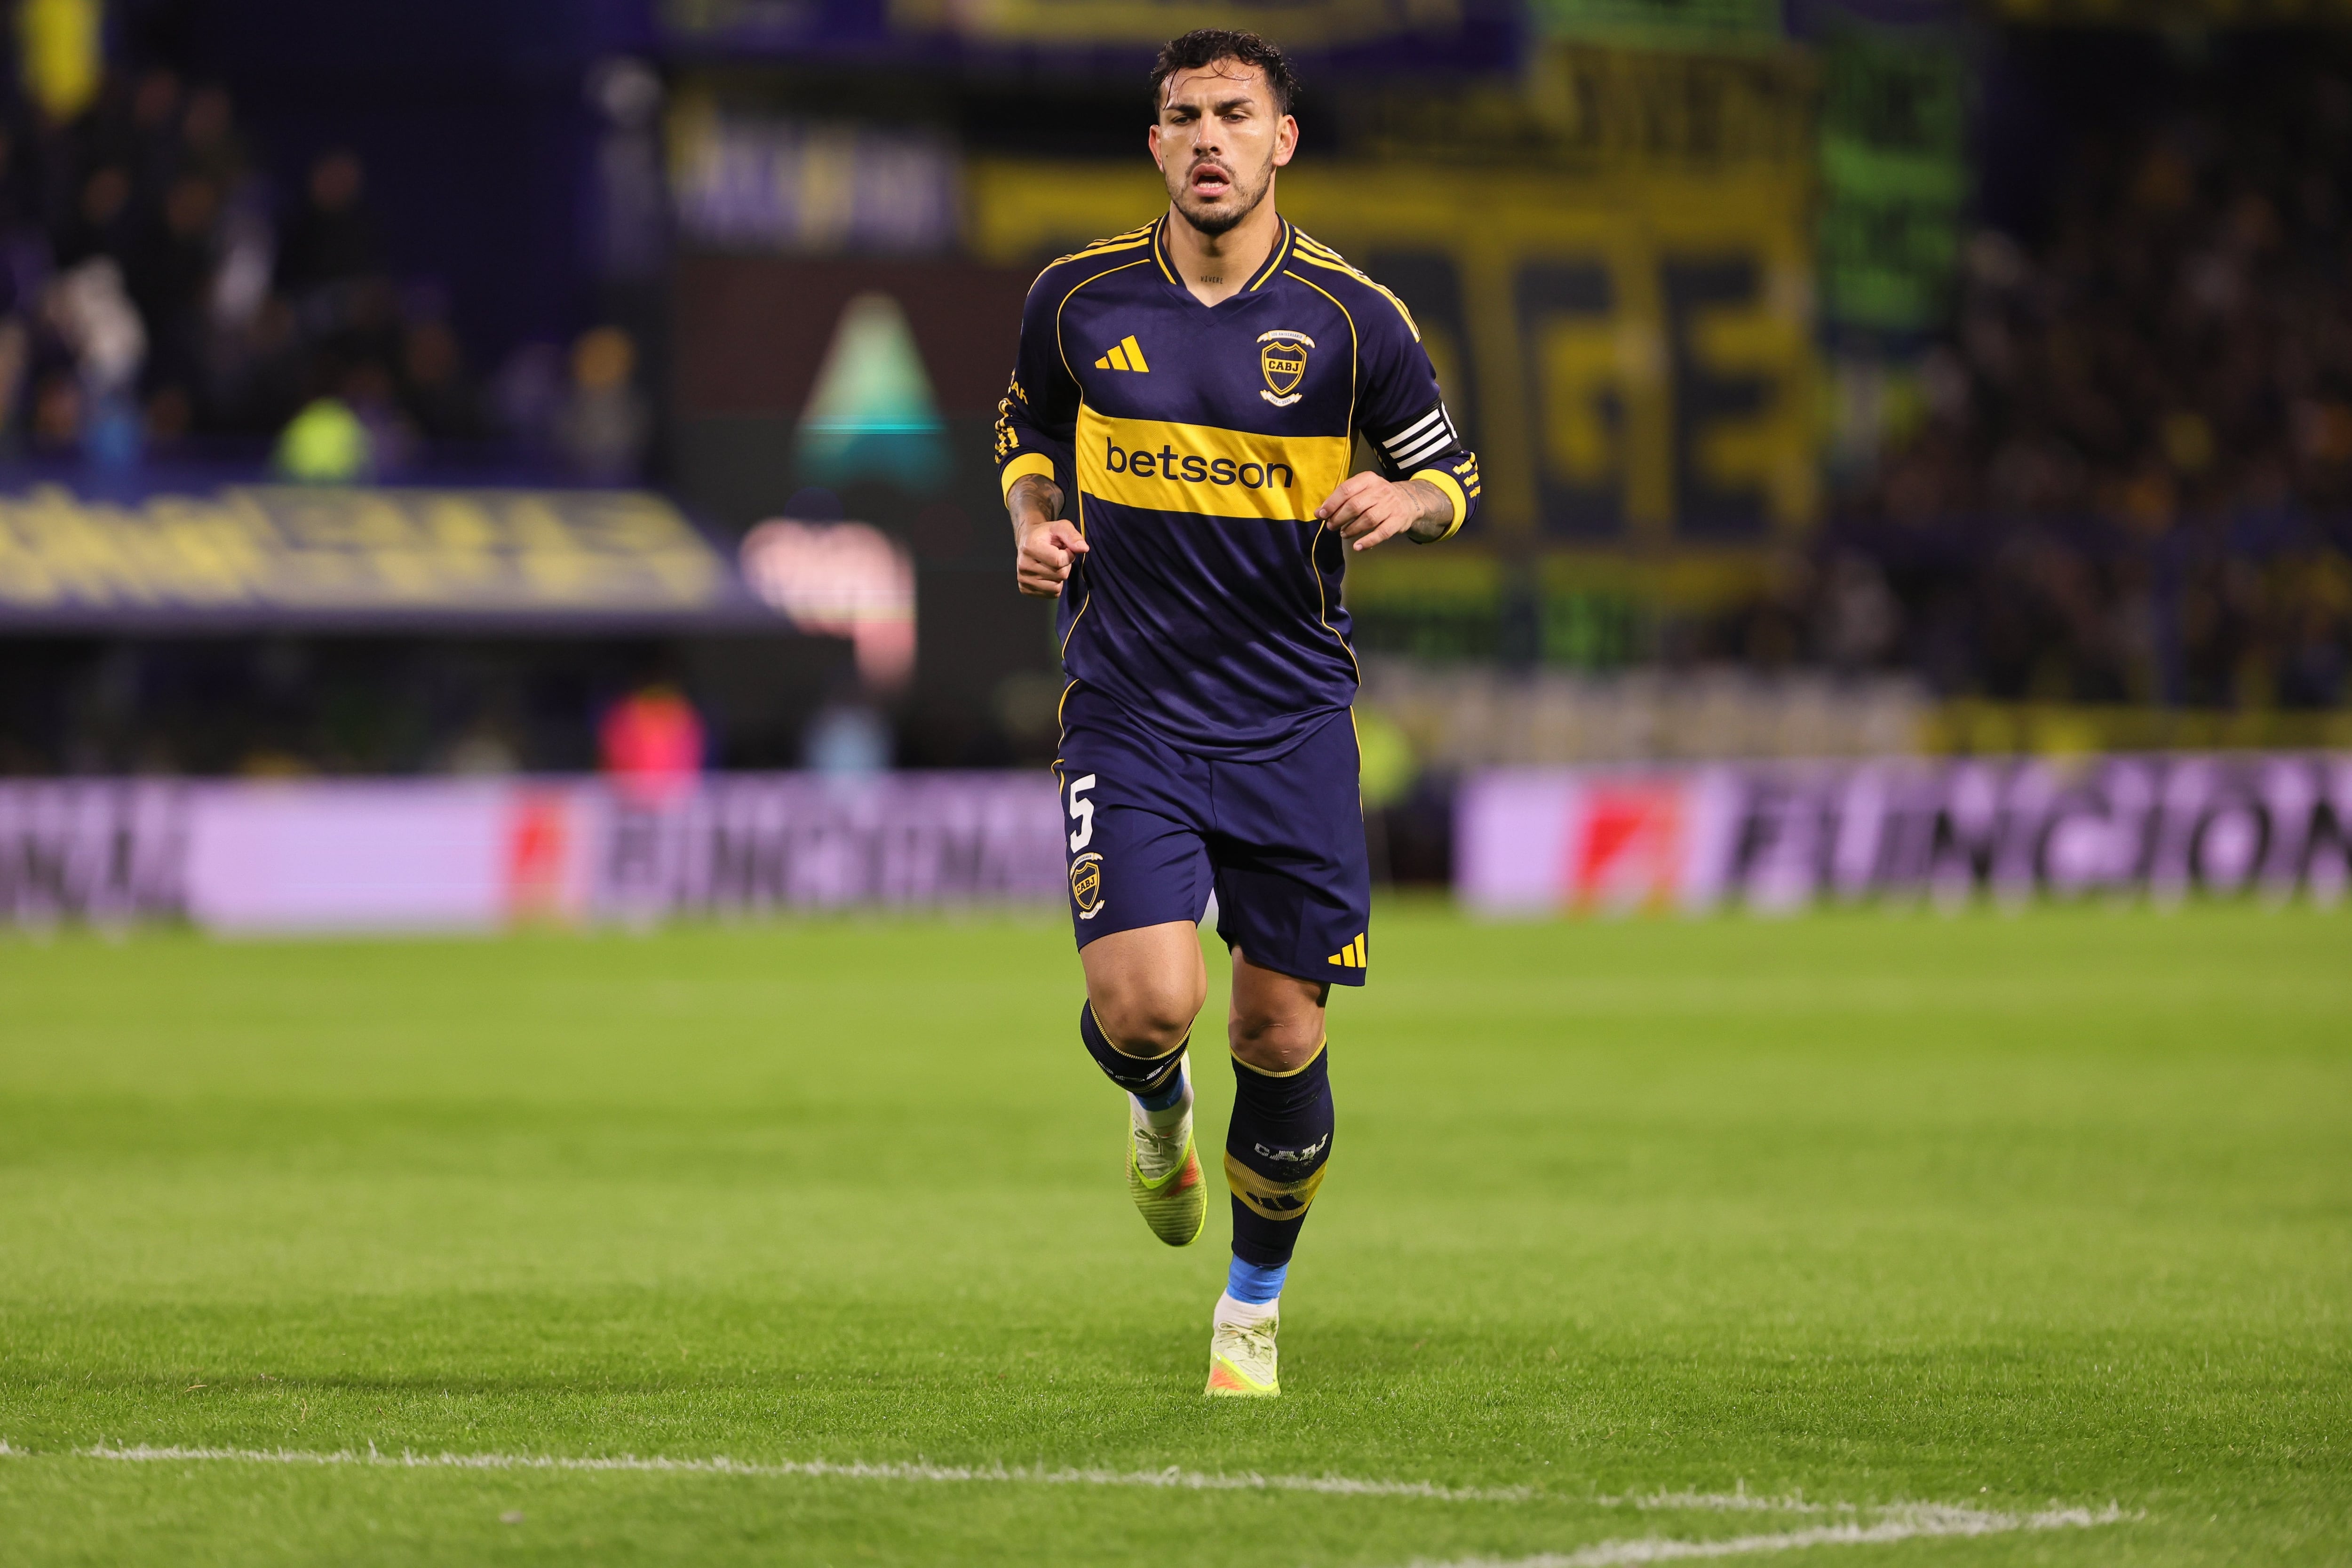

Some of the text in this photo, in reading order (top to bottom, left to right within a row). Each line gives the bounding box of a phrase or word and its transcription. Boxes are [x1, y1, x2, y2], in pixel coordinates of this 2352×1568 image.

[1200, 275, 1223, 284] VIVERE
[1269, 360, 1299, 372] CABJ
[1106, 436, 1294, 489] betsson
[1069, 773, 1096, 854] 5
[1077, 876, 1095, 893] CABJ
